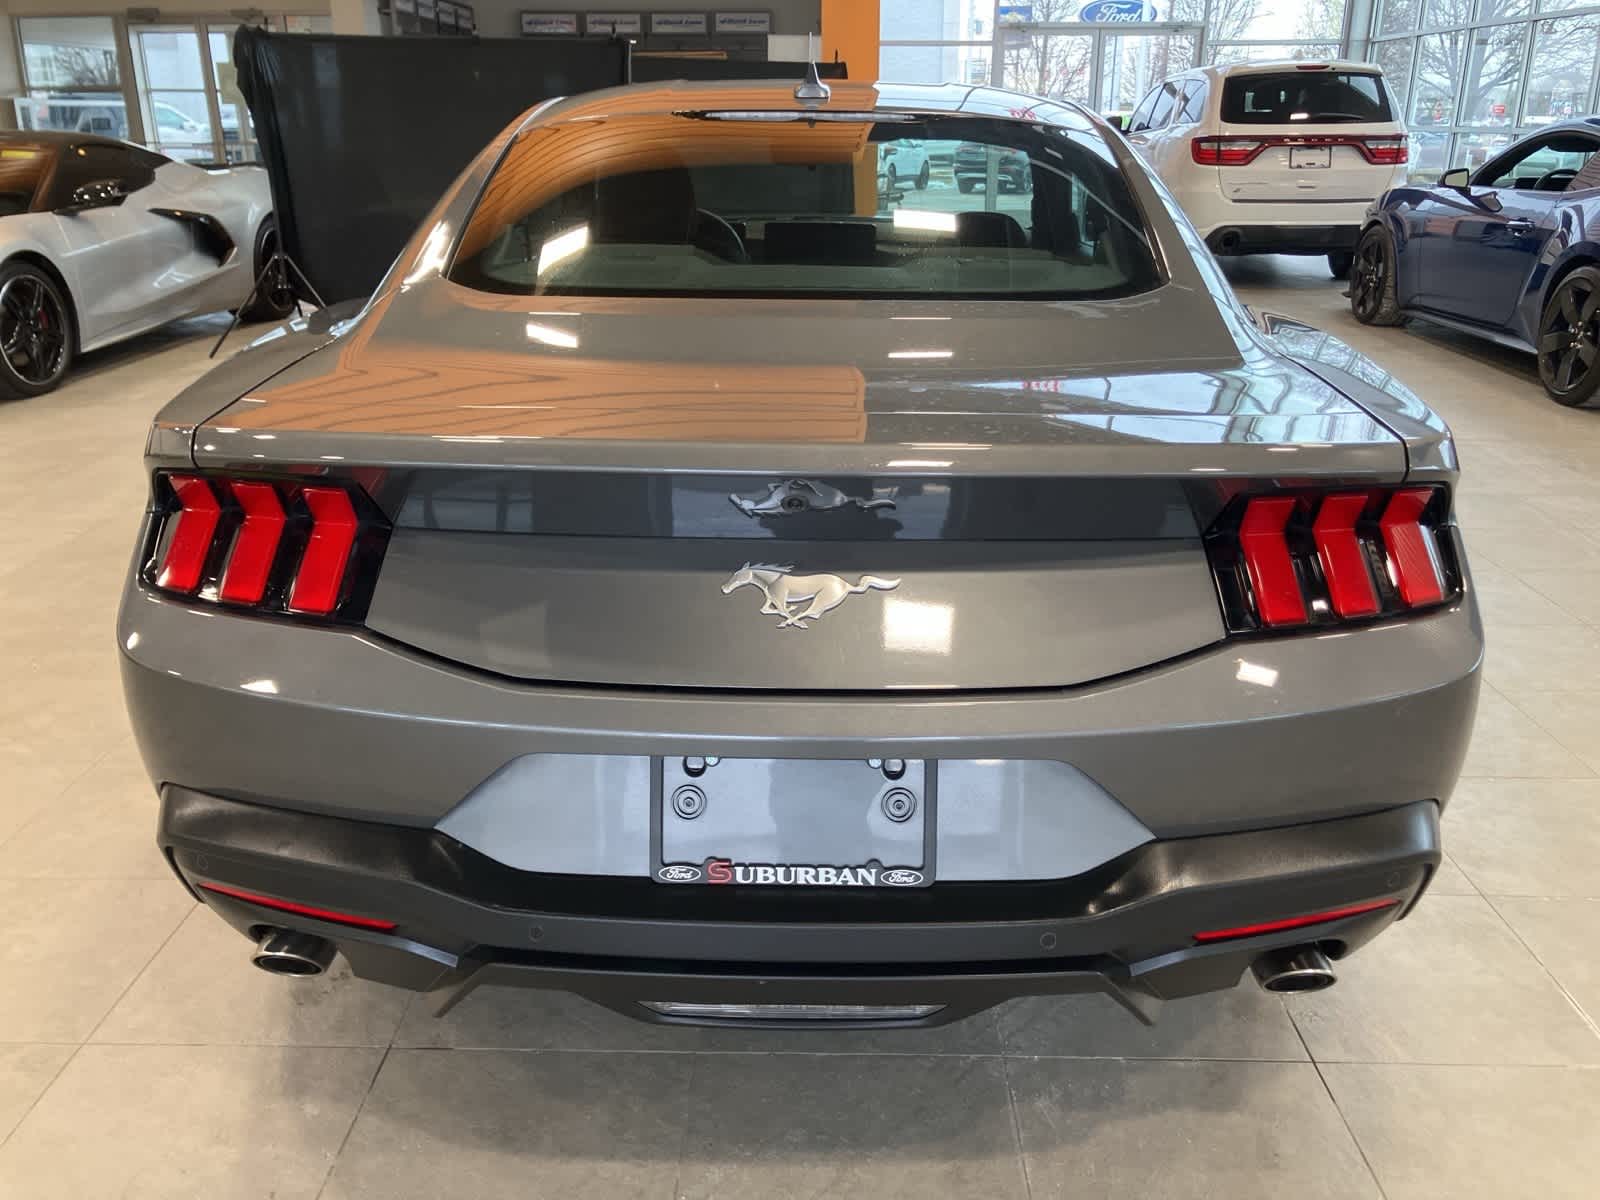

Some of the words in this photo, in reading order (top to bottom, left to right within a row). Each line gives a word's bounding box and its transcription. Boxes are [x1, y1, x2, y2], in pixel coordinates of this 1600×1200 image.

[1094, 3, 1143, 22] Ford
[665, 866, 693, 880] Ford
[707, 861, 878, 885] SUBURBAN
[888, 870, 916, 883] Ford
